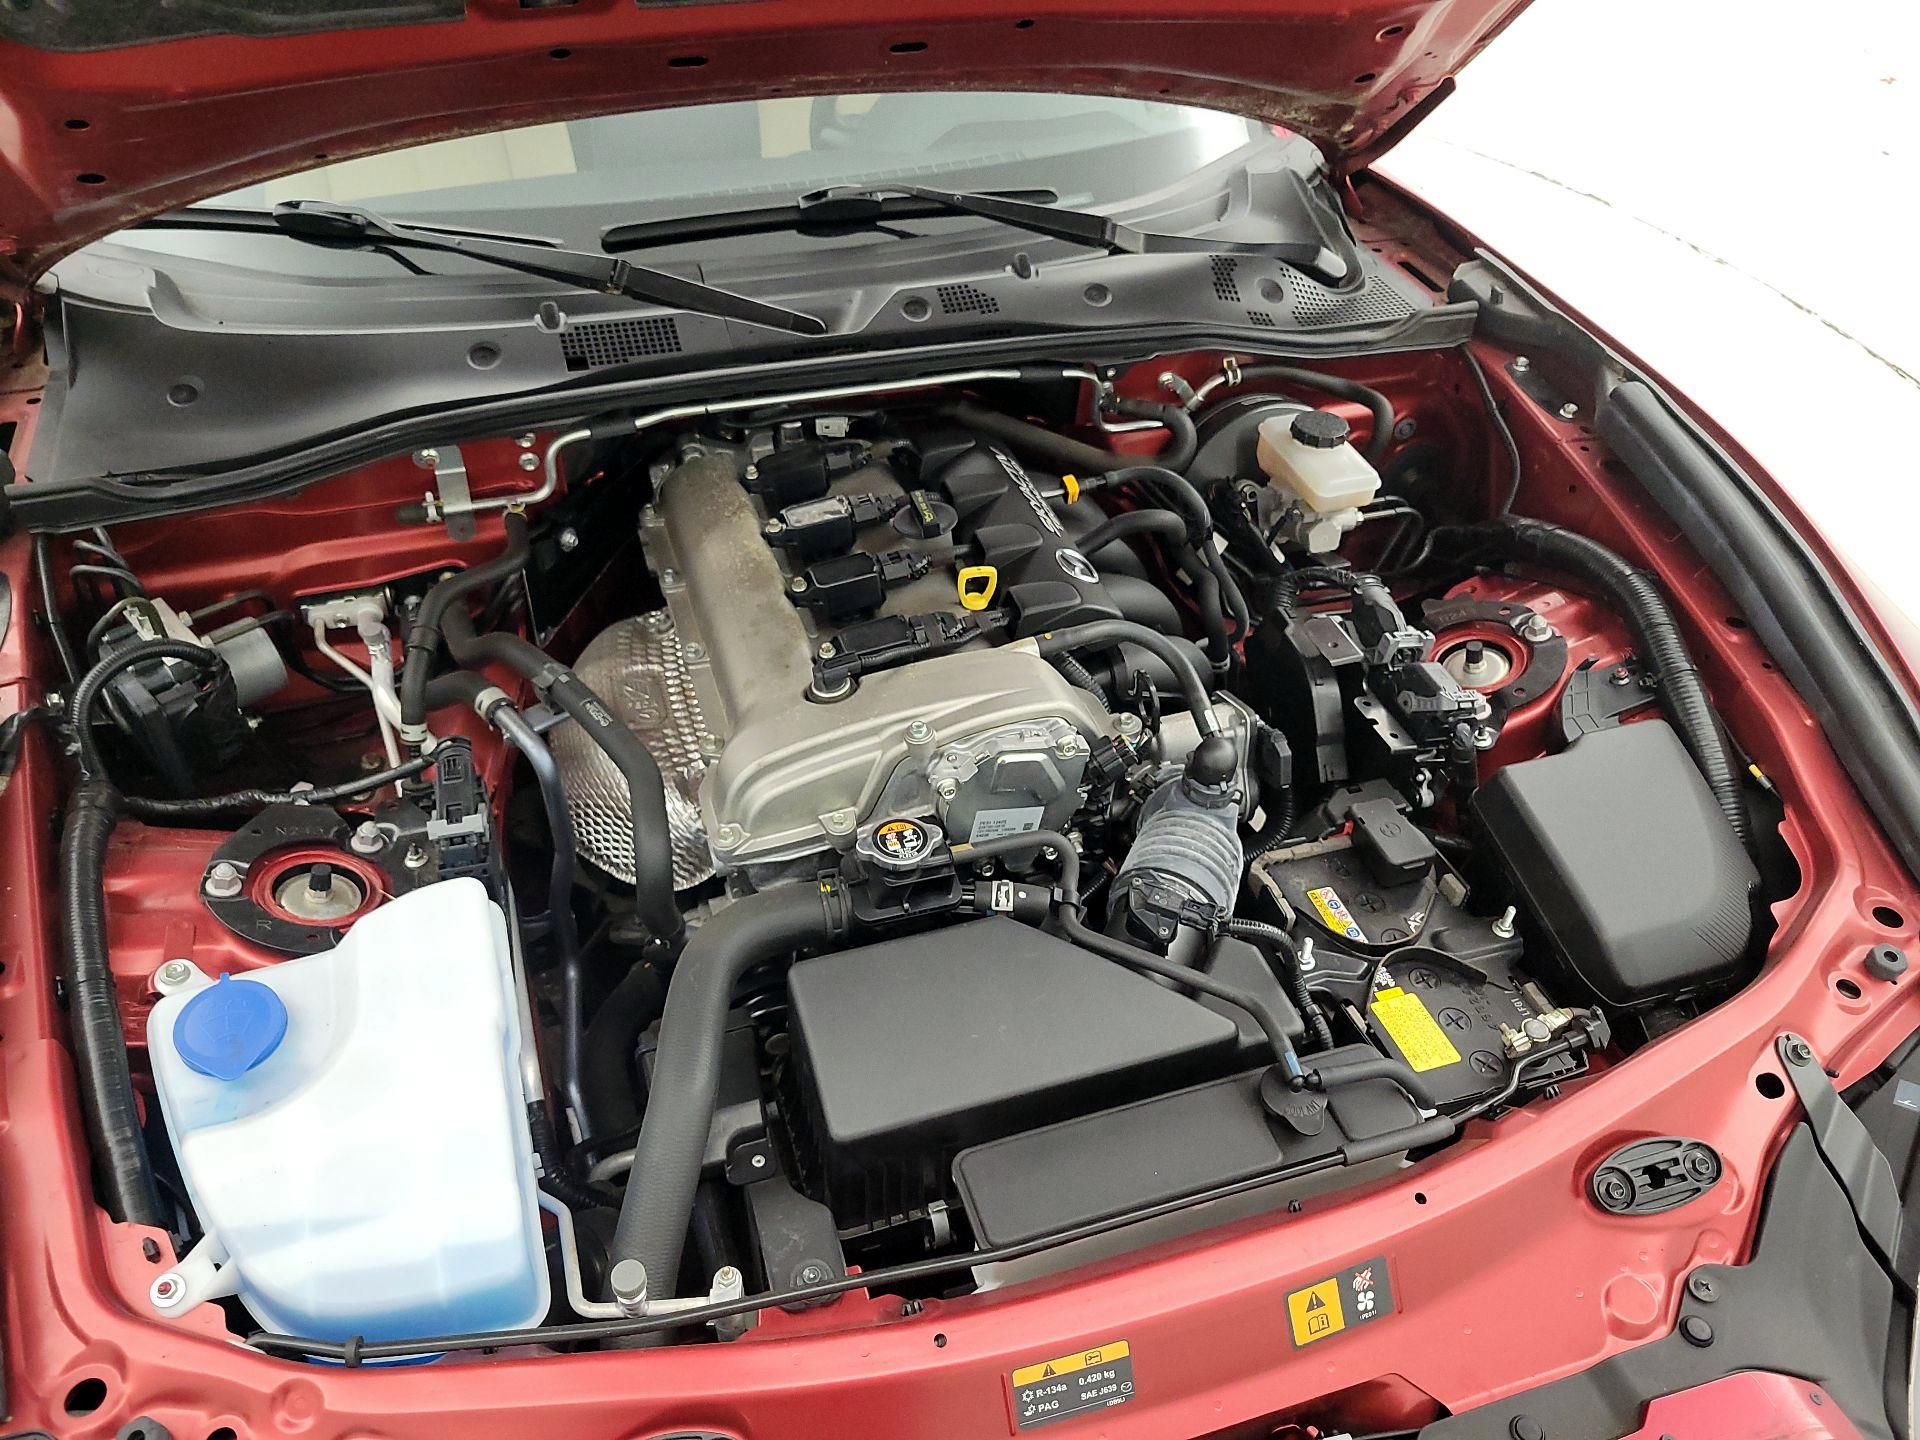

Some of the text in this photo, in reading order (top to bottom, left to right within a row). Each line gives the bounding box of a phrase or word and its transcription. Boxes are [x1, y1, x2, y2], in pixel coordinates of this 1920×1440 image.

[1078, 1370, 1116, 1386] 0.420 kg
[1036, 1383, 1068, 1398] R-134a
[1080, 1384, 1118, 1401] SAE J639
[1038, 1400, 1060, 1413] PAG
